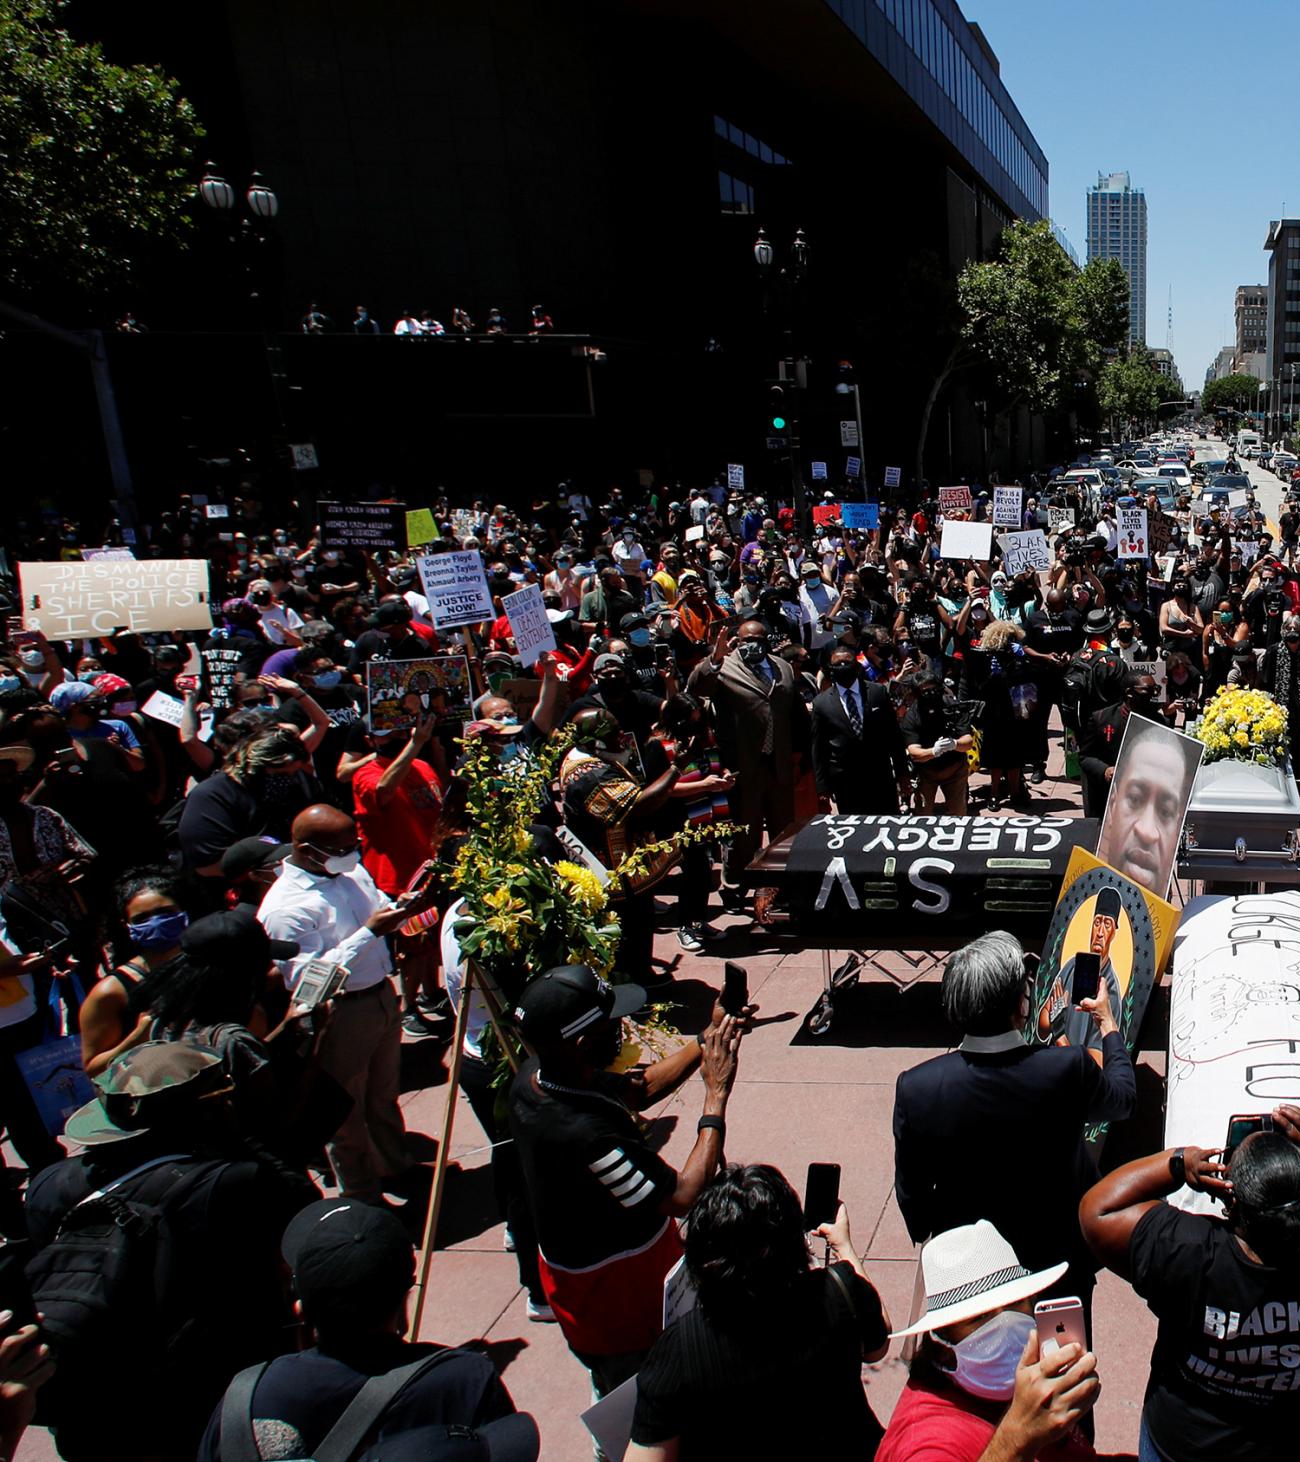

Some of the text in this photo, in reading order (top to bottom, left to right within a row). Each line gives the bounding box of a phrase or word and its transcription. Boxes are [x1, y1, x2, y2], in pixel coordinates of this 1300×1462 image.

[940, 489, 968, 500] RESIST
[996, 497, 1020, 505] REVOLT
[424, 554, 473, 567] George Floyd
[1007, 548, 1044, 563] LIVES
[51, 559, 202, 580] DISMANTLE
[424, 564, 478, 578] Breonna Taylor
[1011, 557, 1050, 574] MATTER
[40, 572, 200, 594] THE POLICE
[427, 574, 482, 588] Ahmaud Arbery
[46, 587, 195, 616] SHERIFFS
[436, 592, 483, 608] JUSTICE
[446, 603, 476, 614] NOW!
[53, 609, 151, 636] ICE
[516, 610, 542, 632] DEATH
[517, 622, 551, 652] SENTENCE
[811, 814, 1074, 828] COMMUNITY
[827, 826, 1062, 852] CLERGY &
